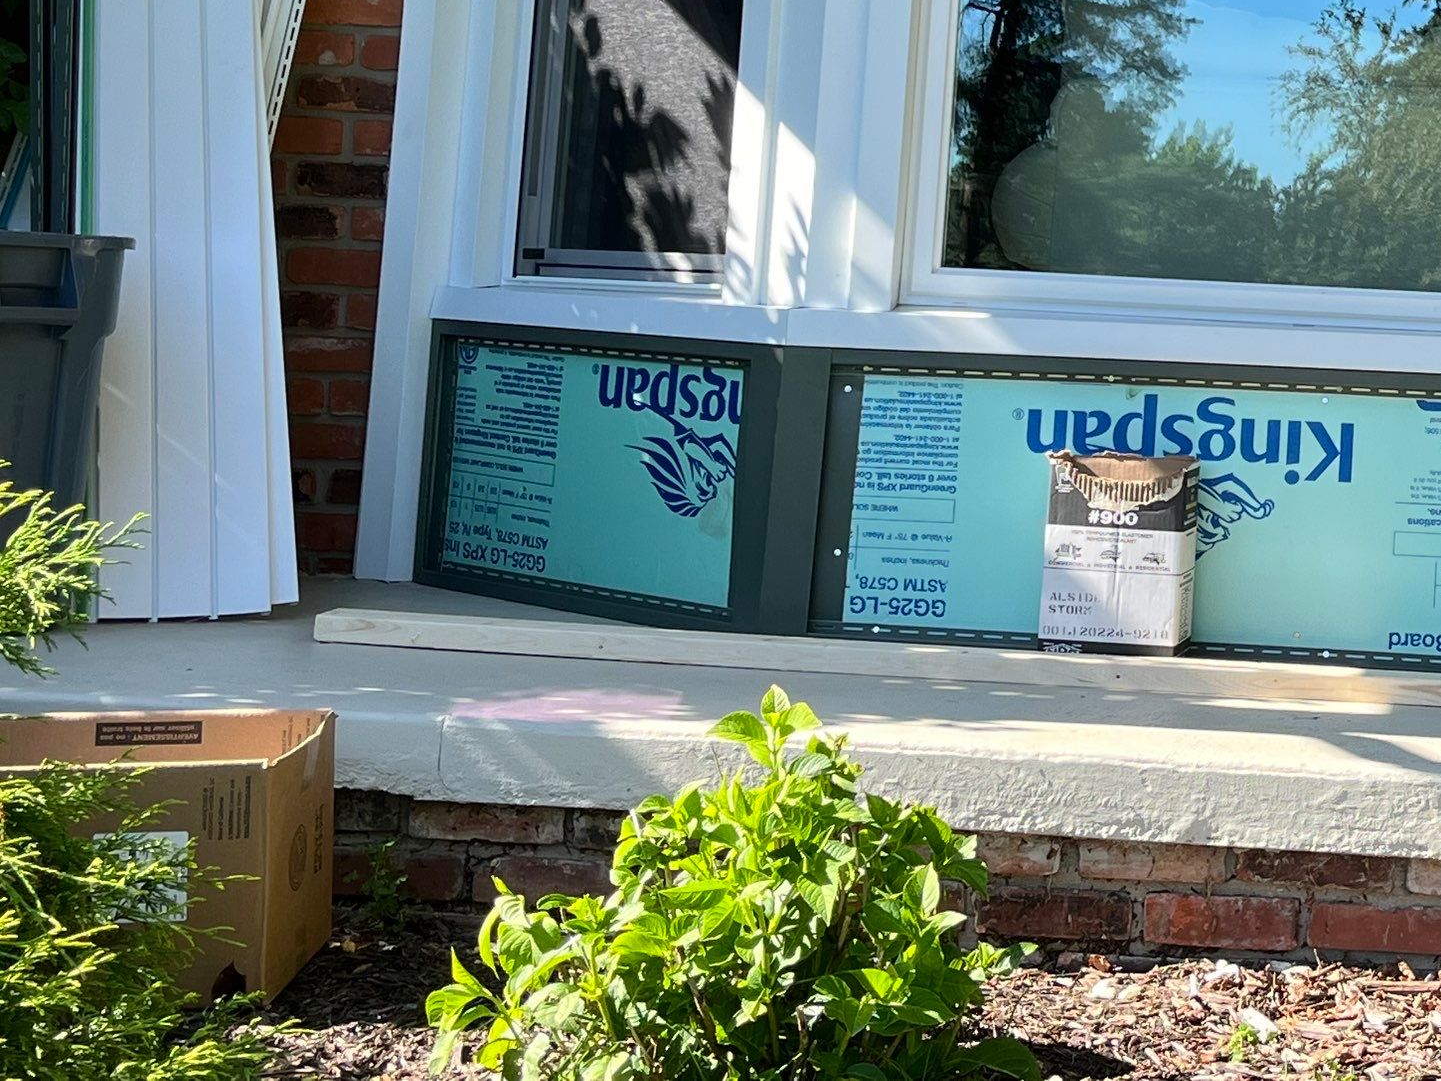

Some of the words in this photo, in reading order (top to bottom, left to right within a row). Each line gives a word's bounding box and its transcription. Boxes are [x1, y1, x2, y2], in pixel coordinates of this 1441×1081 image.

[1026, 393, 1355, 485] Kingspan
[866, 482, 875, 490] is
[877, 482, 897, 492] XPS
[899, 483, 956, 495] GreenGuard
[1087, 509, 1139, 526] #900
[449, 521, 459, 534] 25
[472, 523, 493, 540] Type
[495, 528, 520, 545] C578,
[521, 534, 548, 551] ASTM
[462, 542, 488, 563] XPS
[489, 546, 546, 574] GG25-LG
[854, 574, 899, 591] C578,
[903, 578, 948, 593] ASTM
[849, 596, 946, 617] GG25-LG
[132, 733, 198, 741] AVERTISSEMENT
